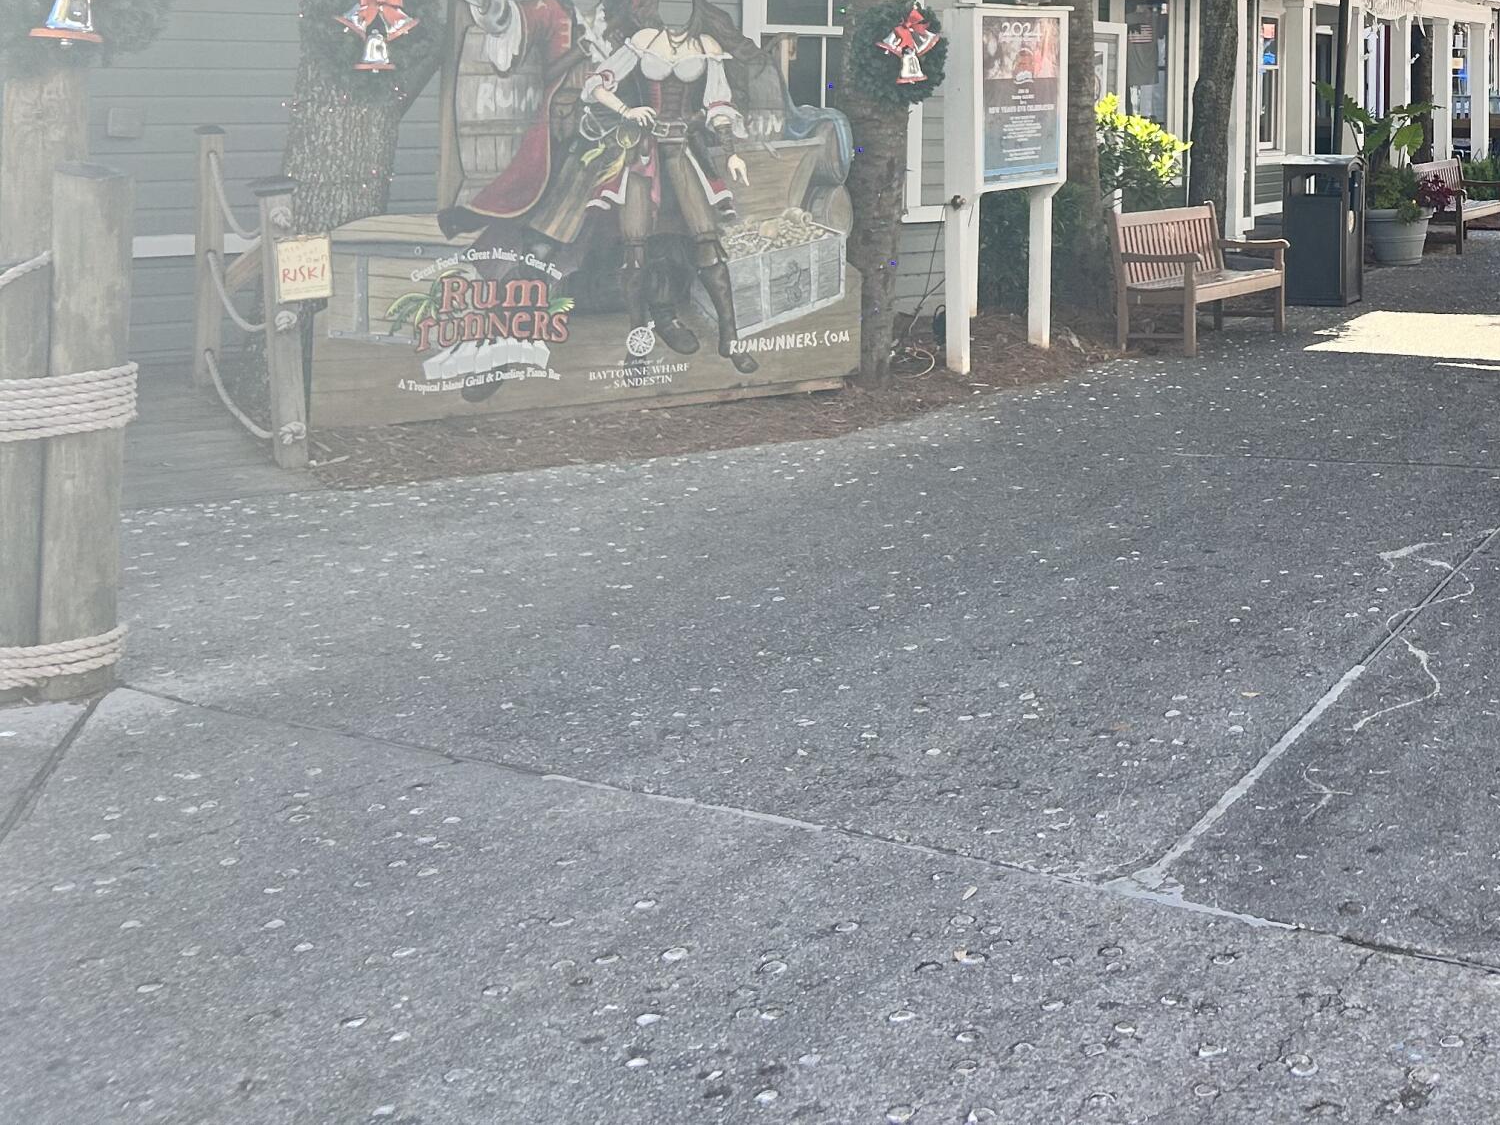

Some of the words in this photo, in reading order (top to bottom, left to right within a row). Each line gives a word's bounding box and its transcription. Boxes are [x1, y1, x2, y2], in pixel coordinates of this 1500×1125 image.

[1001, 22, 1043, 42] 2024
[477, 82, 540, 115] RUM
[282, 263, 326, 283] RISK!
[410, 264, 435, 282] Great
[436, 253, 459, 270] Food
[467, 248, 490, 261] Great
[492, 248, 517, 261] Music
[525, 253, 546, 270] Great
[546, 263, 562, 280] Fun
[729, 330, 850, 355] RUMRUNNERS.COM
[398, 379, 406, 389] A
[407, 380, 440, 395] Tropical
[442, 378, 464, 391] Island
[465, 375, 484, 387] Grill
[486, 374, 494, 383] &
[495, 369, 525, 381] Dueling
[526, 366, 548, 378] Piano
[548, 368, 561, 381] Bar
[588, 367, 649, 381] BAYTOWNE
[652, 362, 690, 374] WHARF
[614, 374, 673, 389] SANDESTIN
